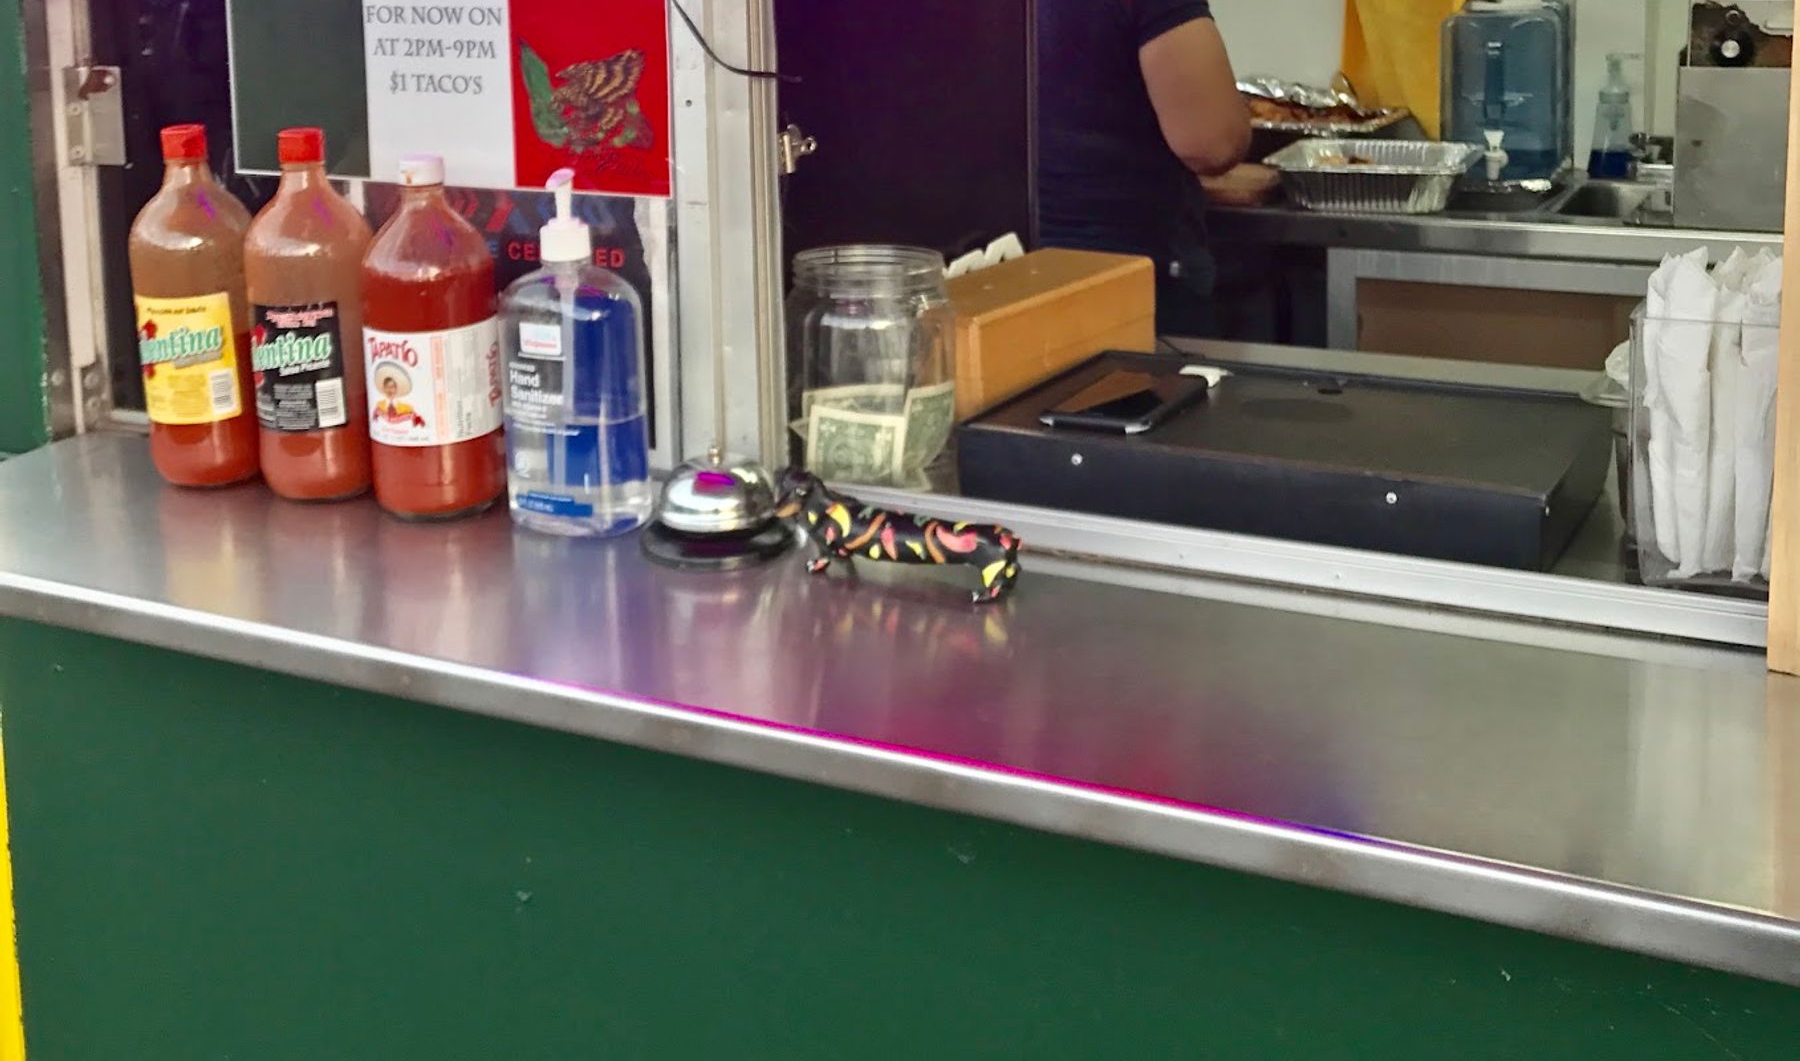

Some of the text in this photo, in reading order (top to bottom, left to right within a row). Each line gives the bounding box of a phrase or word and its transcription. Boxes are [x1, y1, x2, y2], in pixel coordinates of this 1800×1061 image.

[366, 5, 502, 27] FOR NOW ON
[373, 37, 497, 60] AT 2PM-9PM
[390, 70, 484, 96] $1 TACO'S
